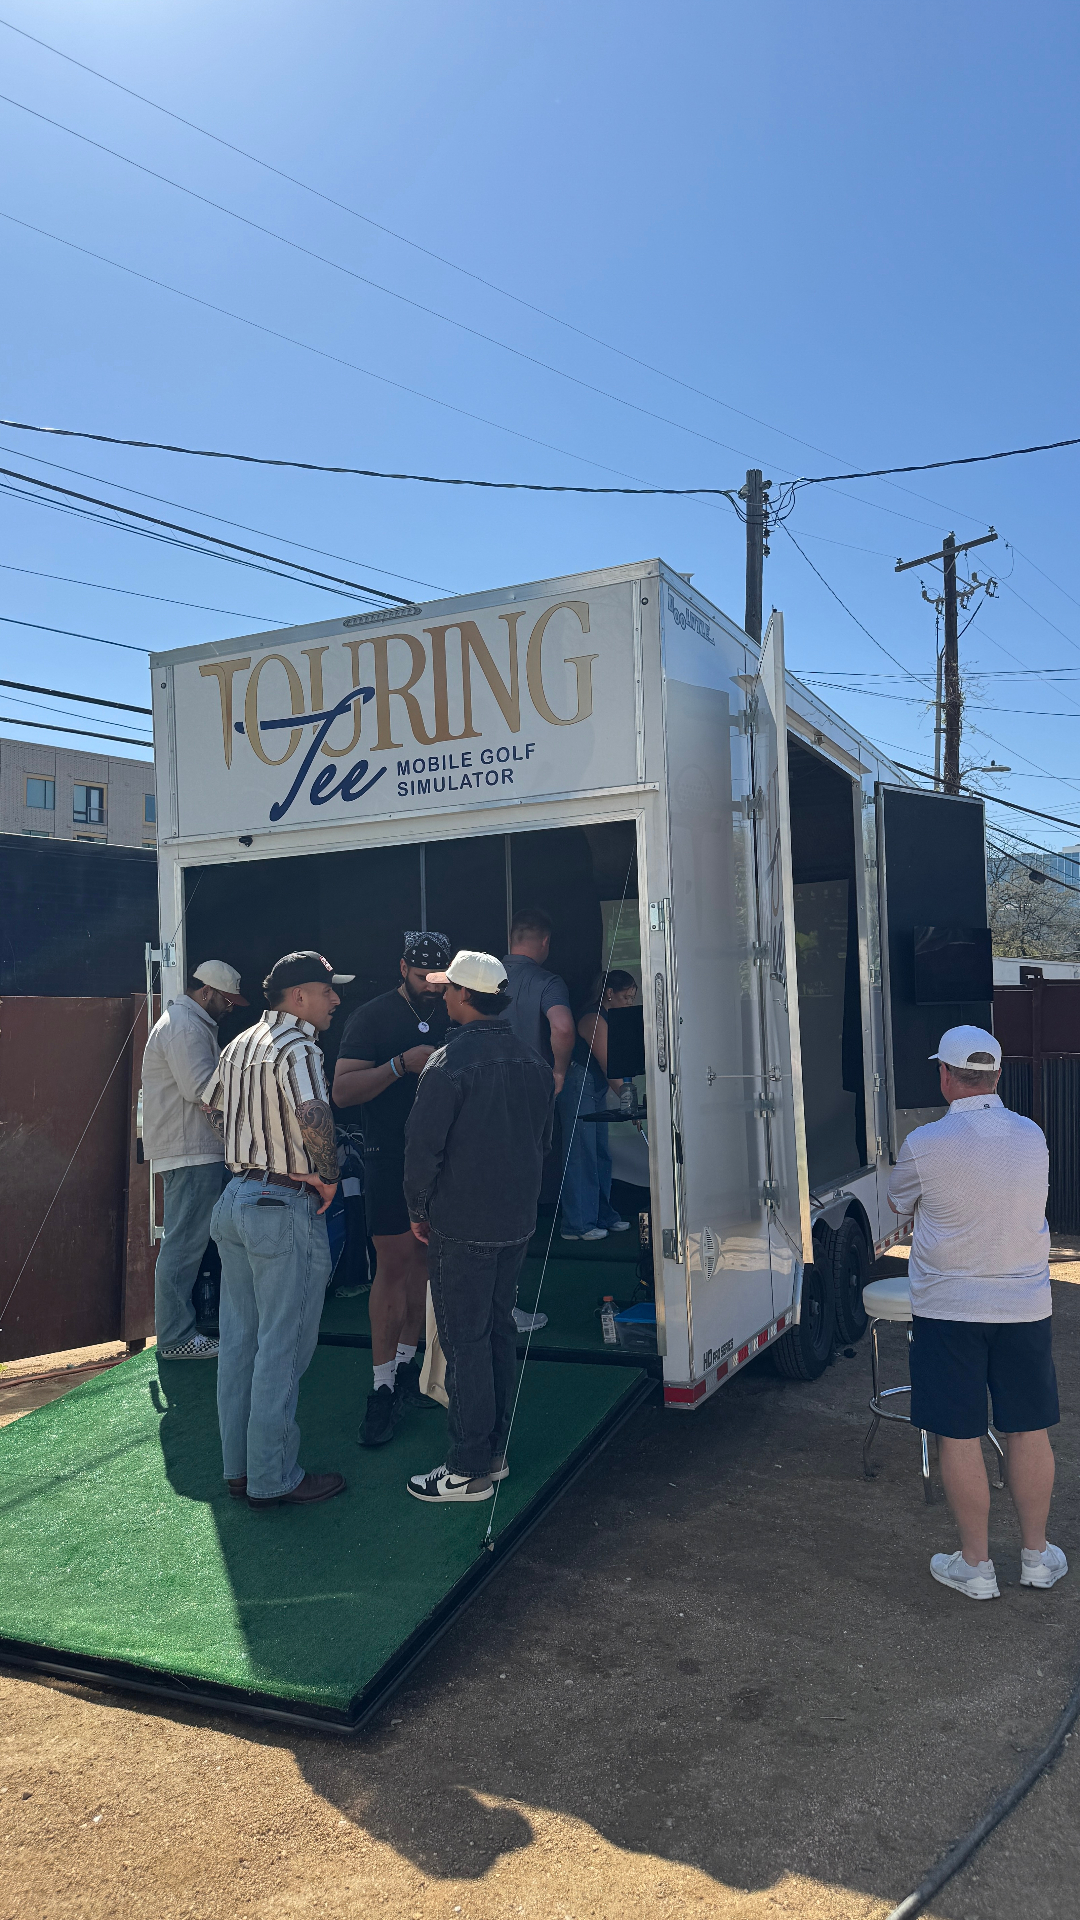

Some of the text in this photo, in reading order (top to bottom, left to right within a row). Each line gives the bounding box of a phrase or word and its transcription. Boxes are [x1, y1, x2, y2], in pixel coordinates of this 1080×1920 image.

[199, 600, 600, 770] TOURING
[234, 686, 387, 822] Tee
[396, 742, 536, 776] MOBILE GOLF
[397, 766, 514, 797] SIMULATOR
[703, 1348, 712, 1372] HD
